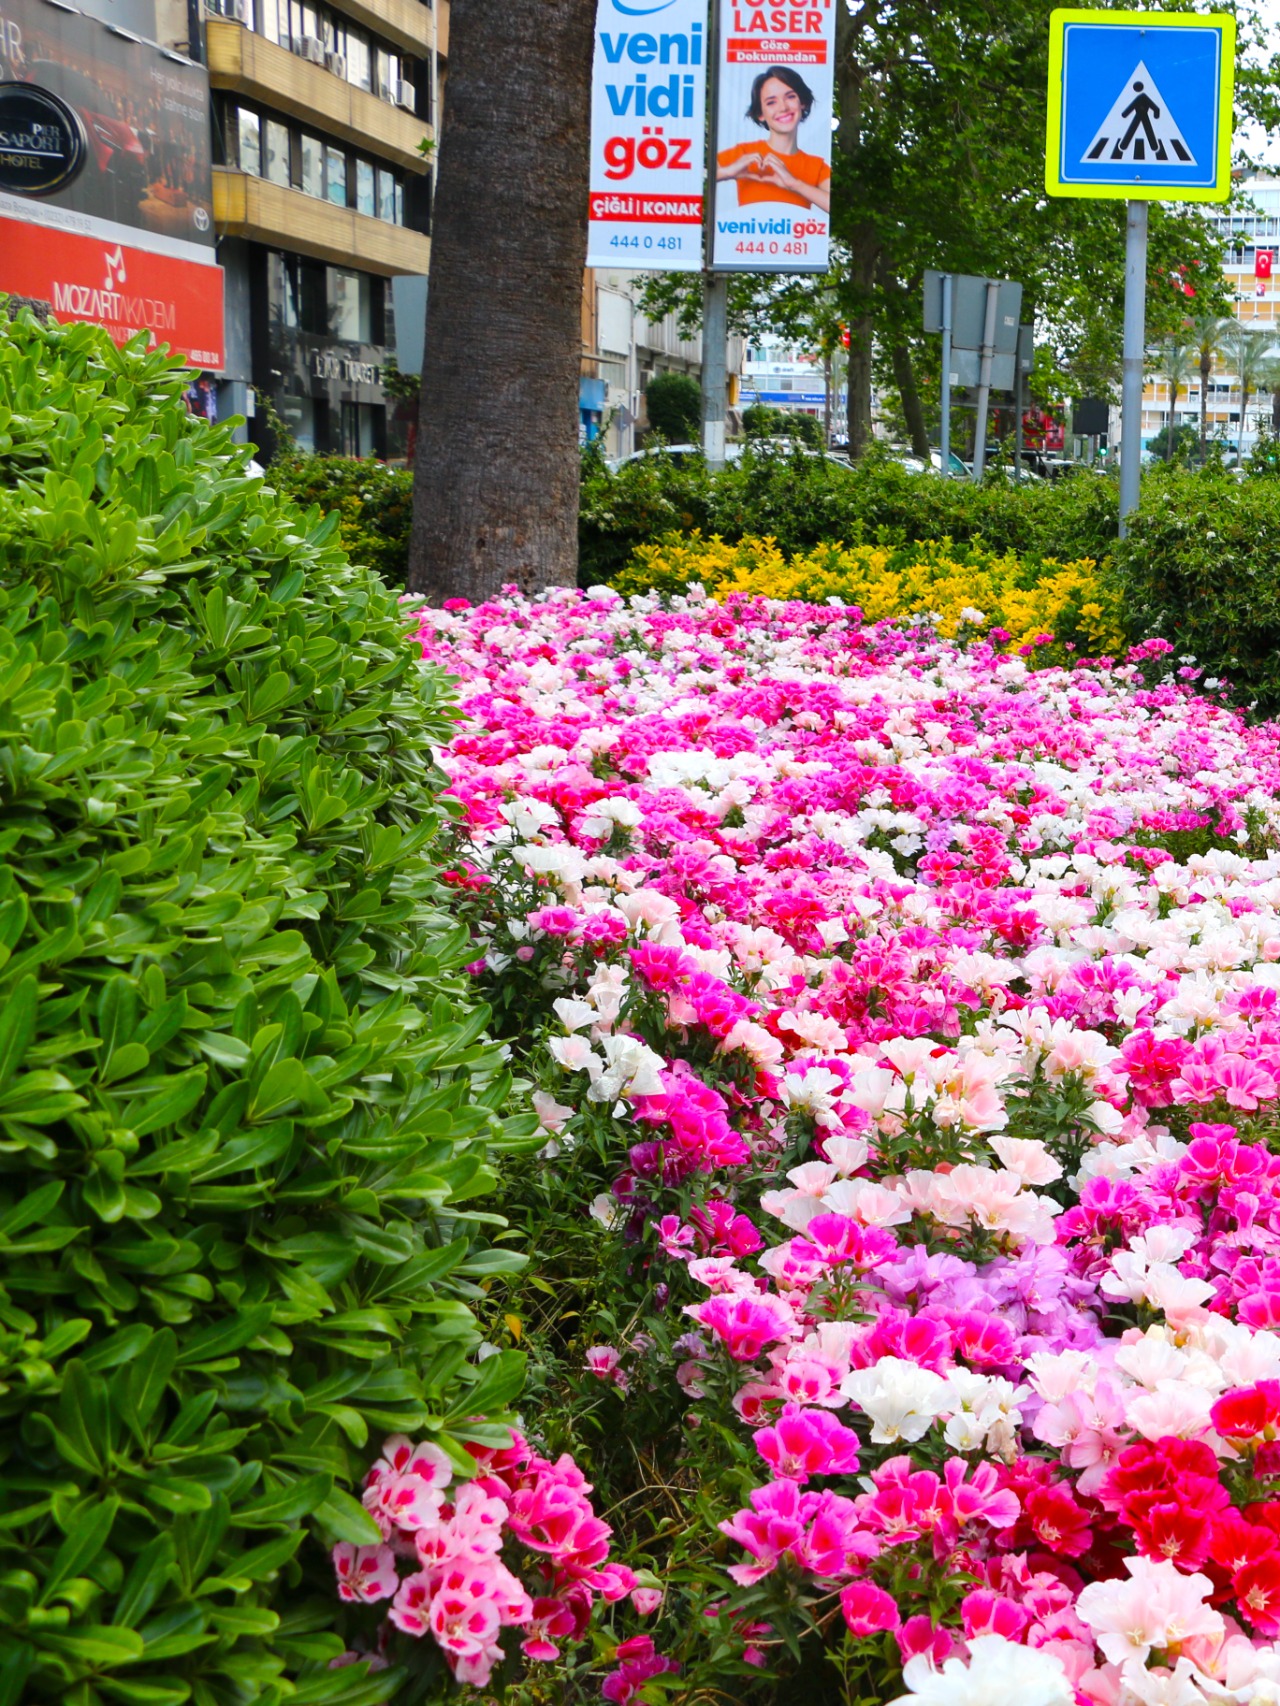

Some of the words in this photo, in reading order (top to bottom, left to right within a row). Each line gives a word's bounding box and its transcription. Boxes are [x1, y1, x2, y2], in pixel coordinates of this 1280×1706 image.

[734, 10, 823, 33] LASER
[600, 22, 702, 65] veni
[760, 40, 790, 50] Göze
[736, 51, 817, 62] Dokunmadan
[605, 73, 694, 118] vidi
[603, 126, 692, 181] göz
[592, 196, 633, 218] ÇİĞLİ
[642, 200, 700, 217] KONAK
[717, 218, 755, 235] veni
[758, 219, 790, 235] vidi
[793, 219, 826, 239] göz
[610, 235, 639, 248] 444
[643, 236, 652, 248] 0
[657, 236, 682, 250] 481
[735, 241, 765, 254] 444
[769, 242, 778, 254] 0
[783, 242, 808, 255] 481
